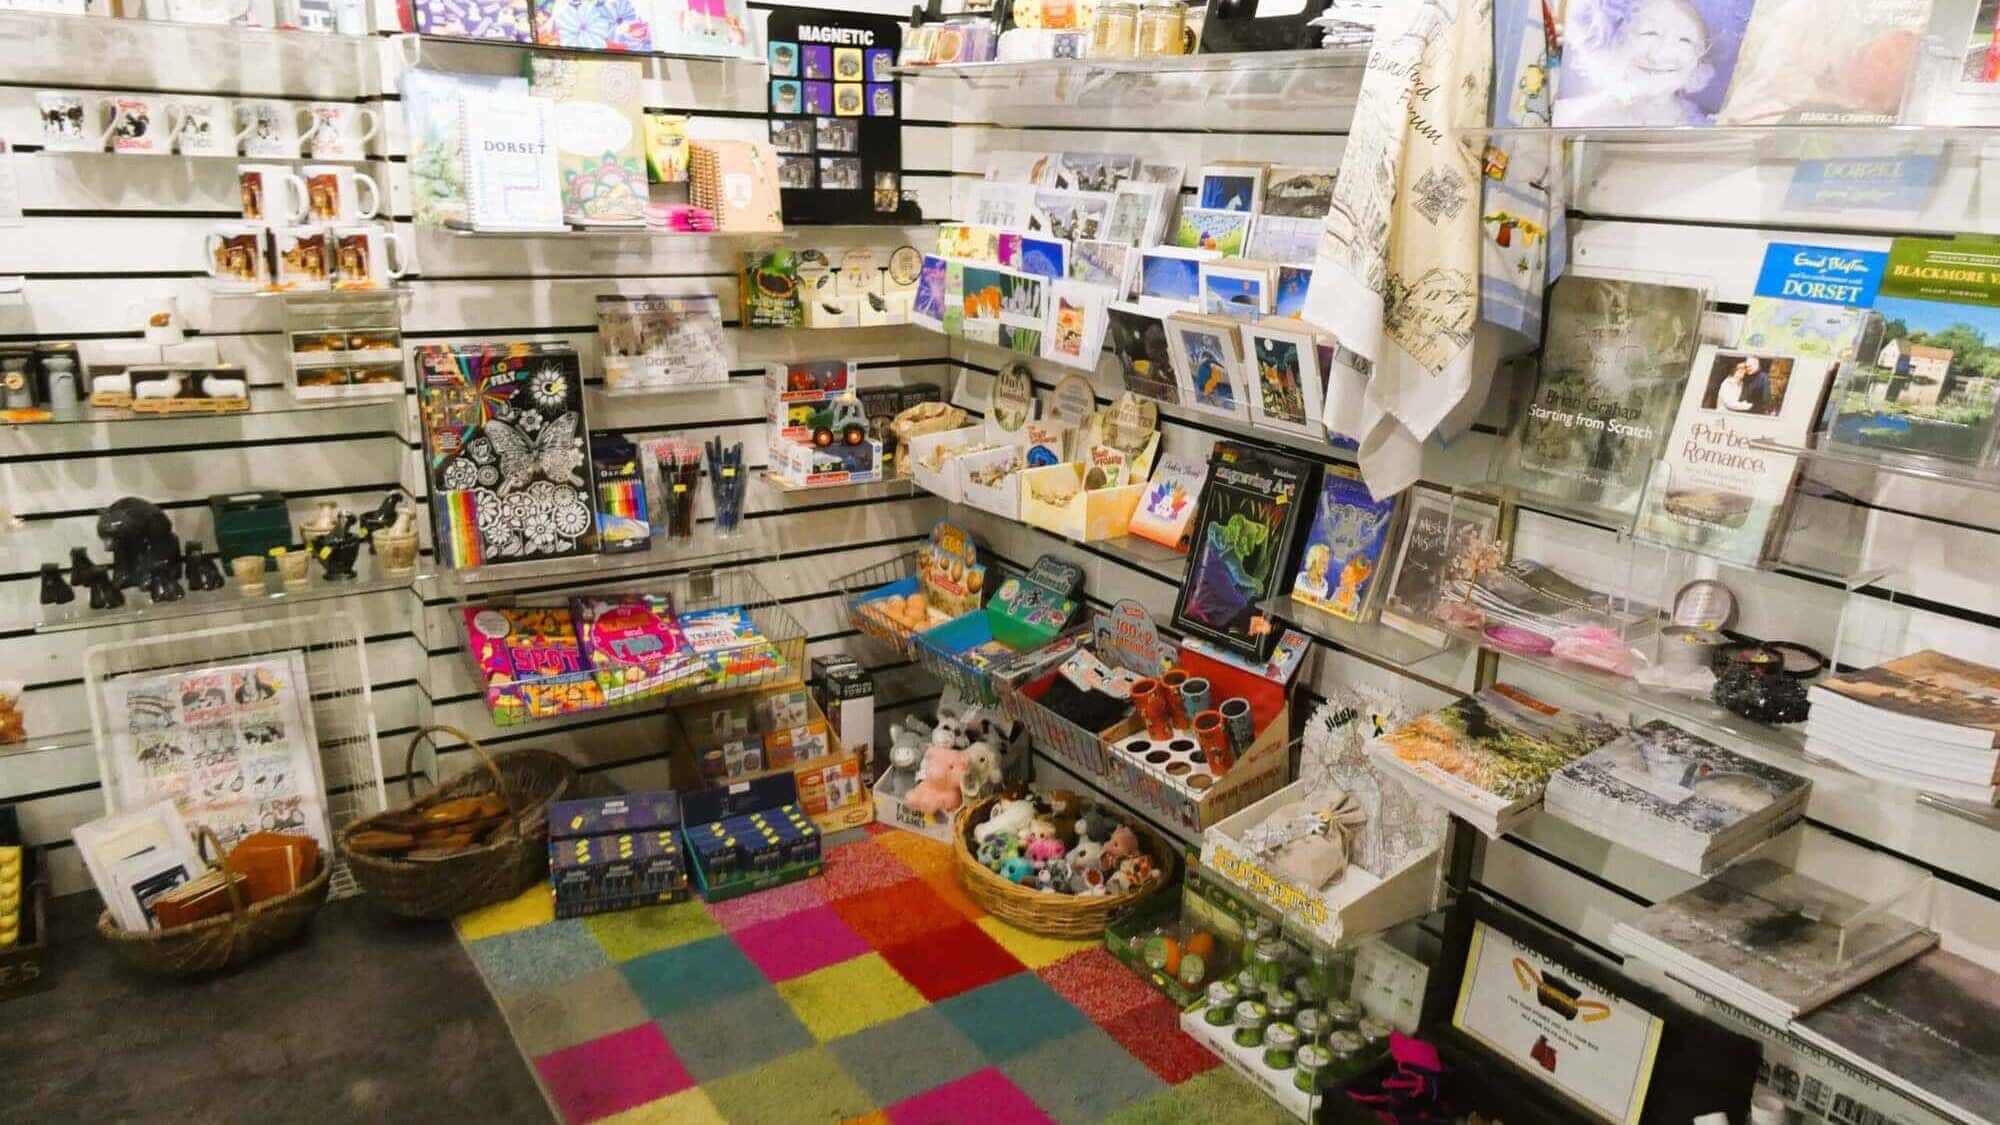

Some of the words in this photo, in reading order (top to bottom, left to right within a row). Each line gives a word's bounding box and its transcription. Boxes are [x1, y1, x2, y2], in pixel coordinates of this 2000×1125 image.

[798, 25, 874, 46] MAGNETIC
[484, 140, 547, 155] DORSET
[1793, 252, 1826, 272] Enid
[1829, 256, 1870, 274] Blyton
[1893, 264, 1986, 283] BLACKMORE
[1782, 279, 1864, 303] DORSET
[490, 371, 516, 386] FELT
[1547, 389, 1581, 410] Brian
[1586, 396, 1642, 421] Graham
[1528, 403, 1575, 428] Starting
[1575, 412, 1605, 431] from
[1607, 418, 1653, 441] Scratch
[511, 646, 582, 672] SPOT
